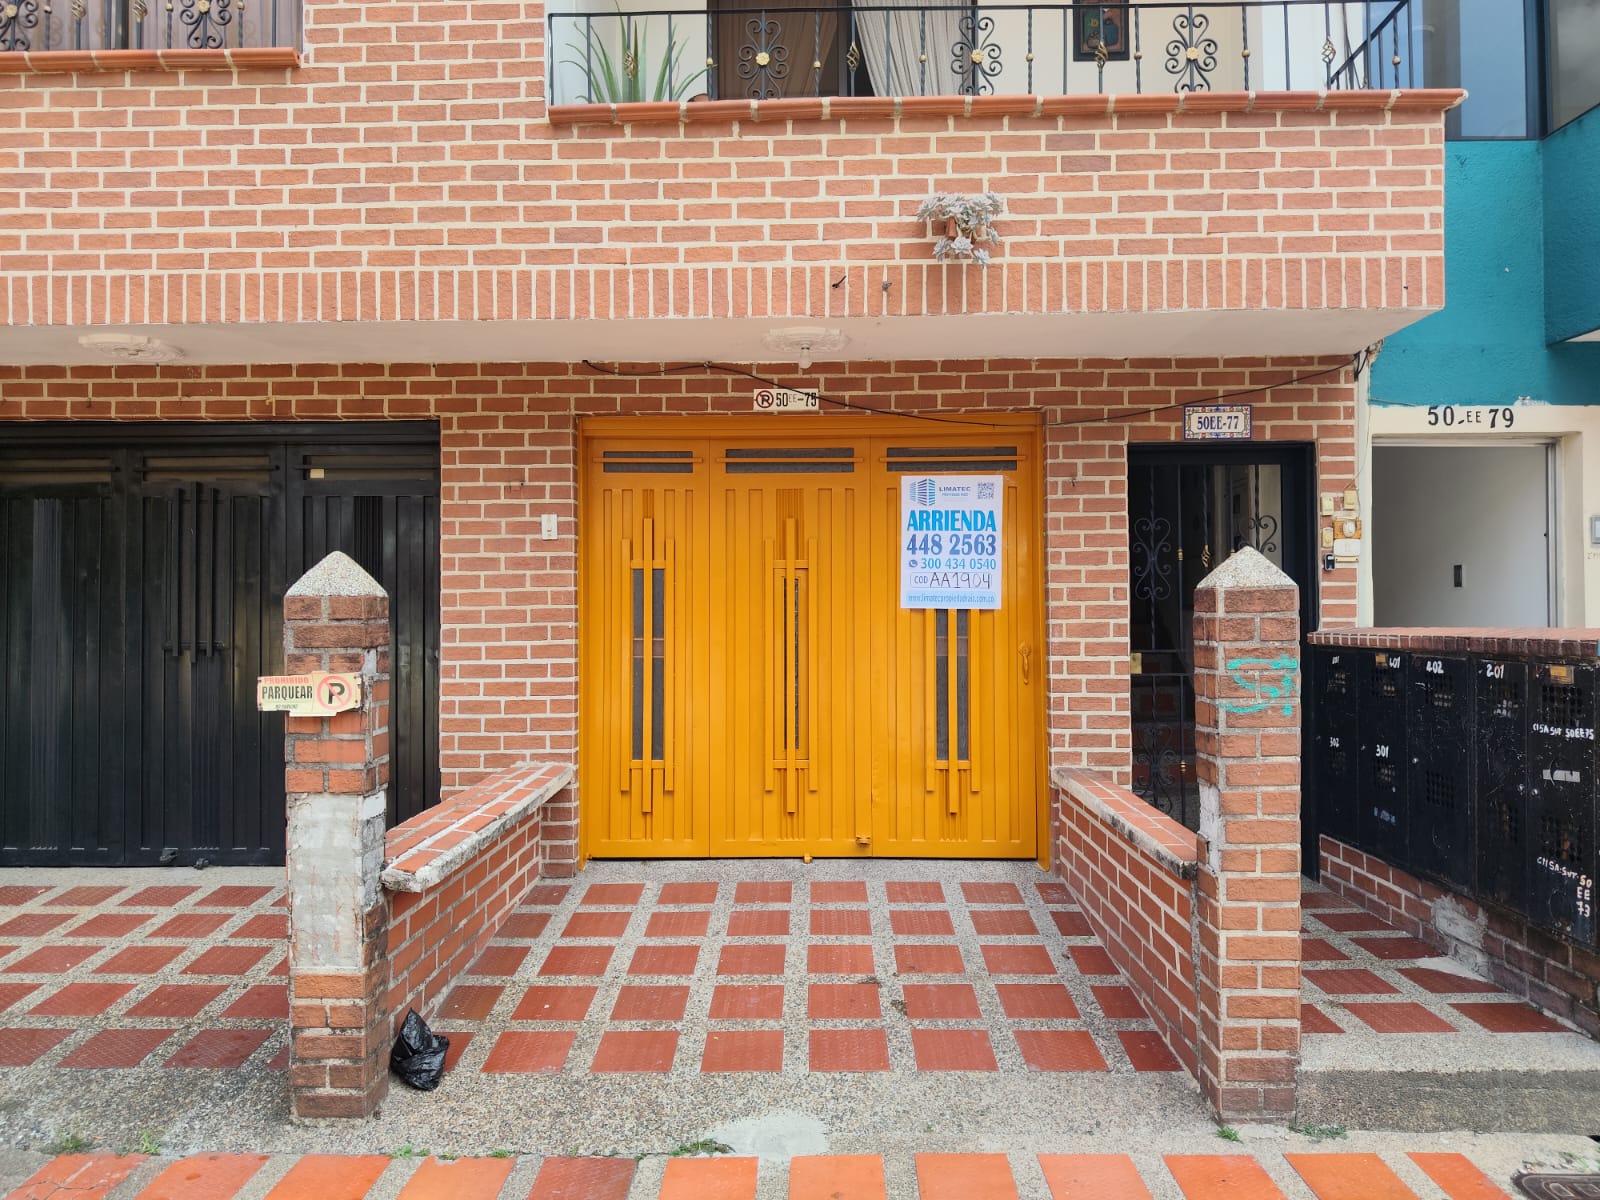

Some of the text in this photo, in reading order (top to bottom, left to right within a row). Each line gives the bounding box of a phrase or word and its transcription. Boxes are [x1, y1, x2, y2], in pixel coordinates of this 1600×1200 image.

[1197, 415, 1239, 430] 50EE-77
[1488, 408, 1514, 428] 79
[907, 510, 996, 531] ARRIENDA
[907, 534, 996, 555] 448 2563
[921, 558, 996, 569] 300 434 0540
[914, 575, 928, 584] COD
[1426, 661, 1444, 674] 402
[1486, 664, 1505, 679] 201
[262, 686, 312, 700] PARQUEAR
[1375, 744, 1389, 758] 301
[1575, 901, 1591, 918] 73
